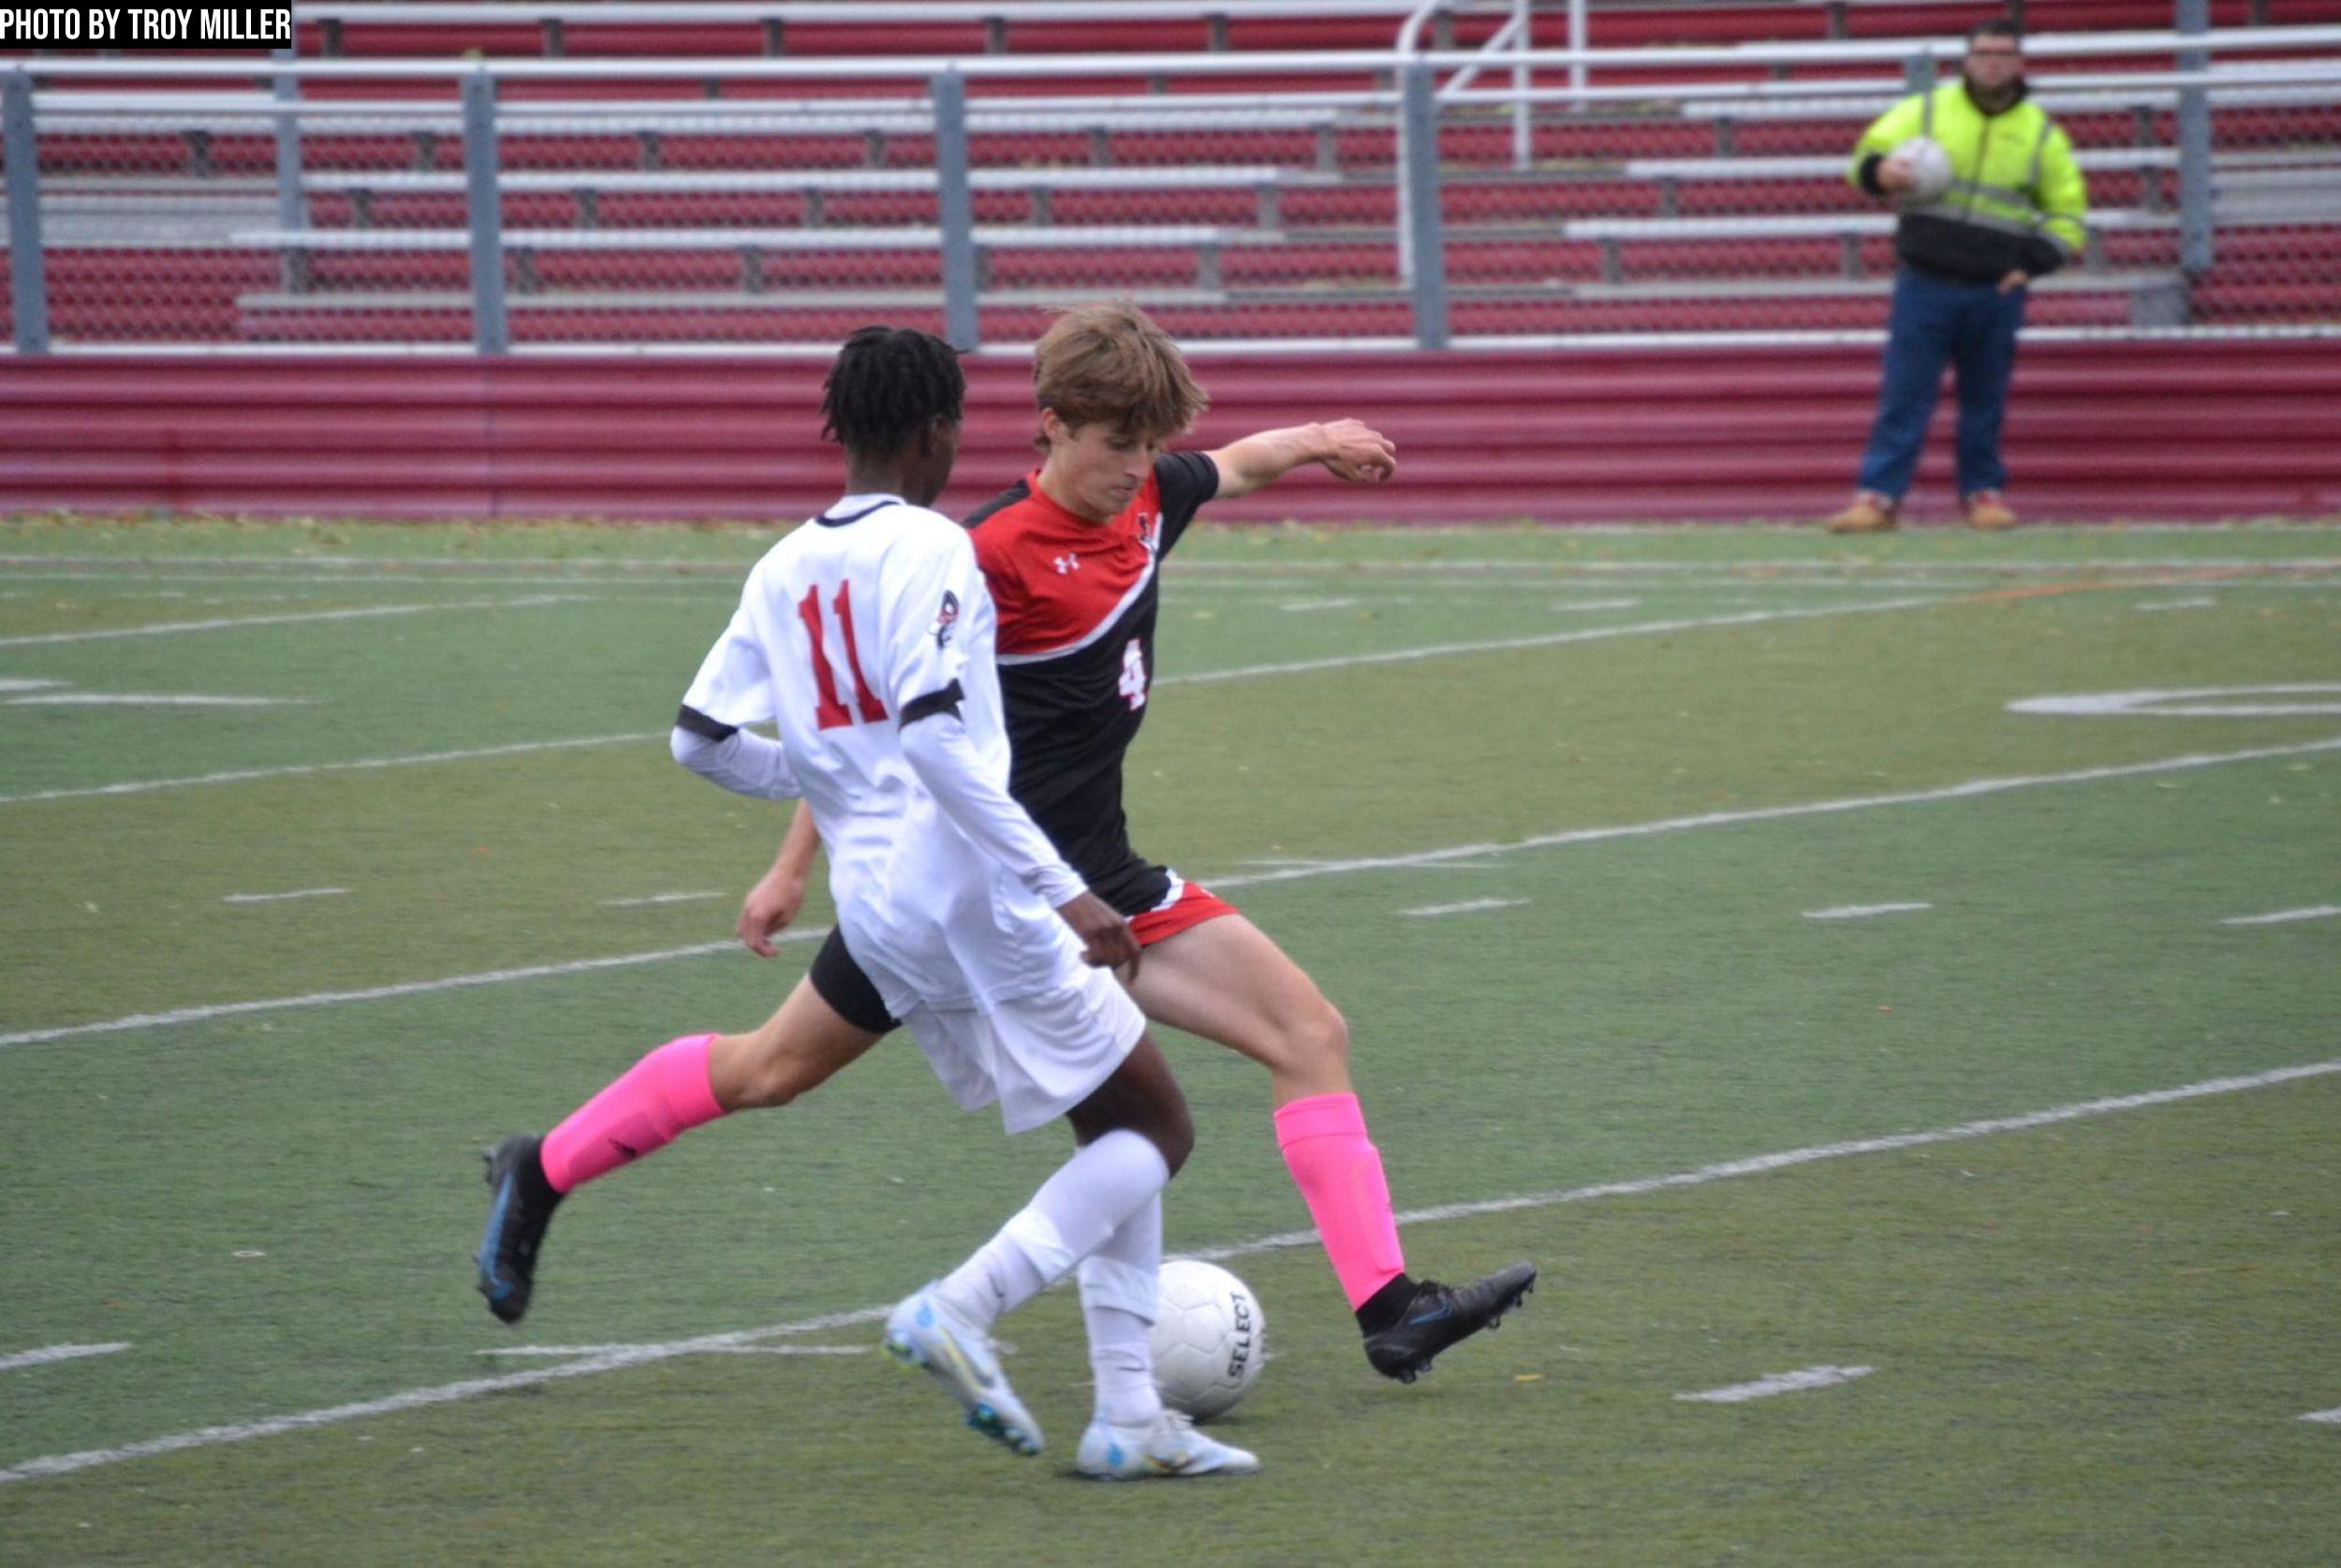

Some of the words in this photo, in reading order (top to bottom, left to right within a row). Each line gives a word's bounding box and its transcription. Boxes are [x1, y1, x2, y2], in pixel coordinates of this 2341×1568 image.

[798, 579, 889, 731] 11
[1117, 637, 1147, 712] 4
[1229, 1292, 1250, 1379] SELECT
